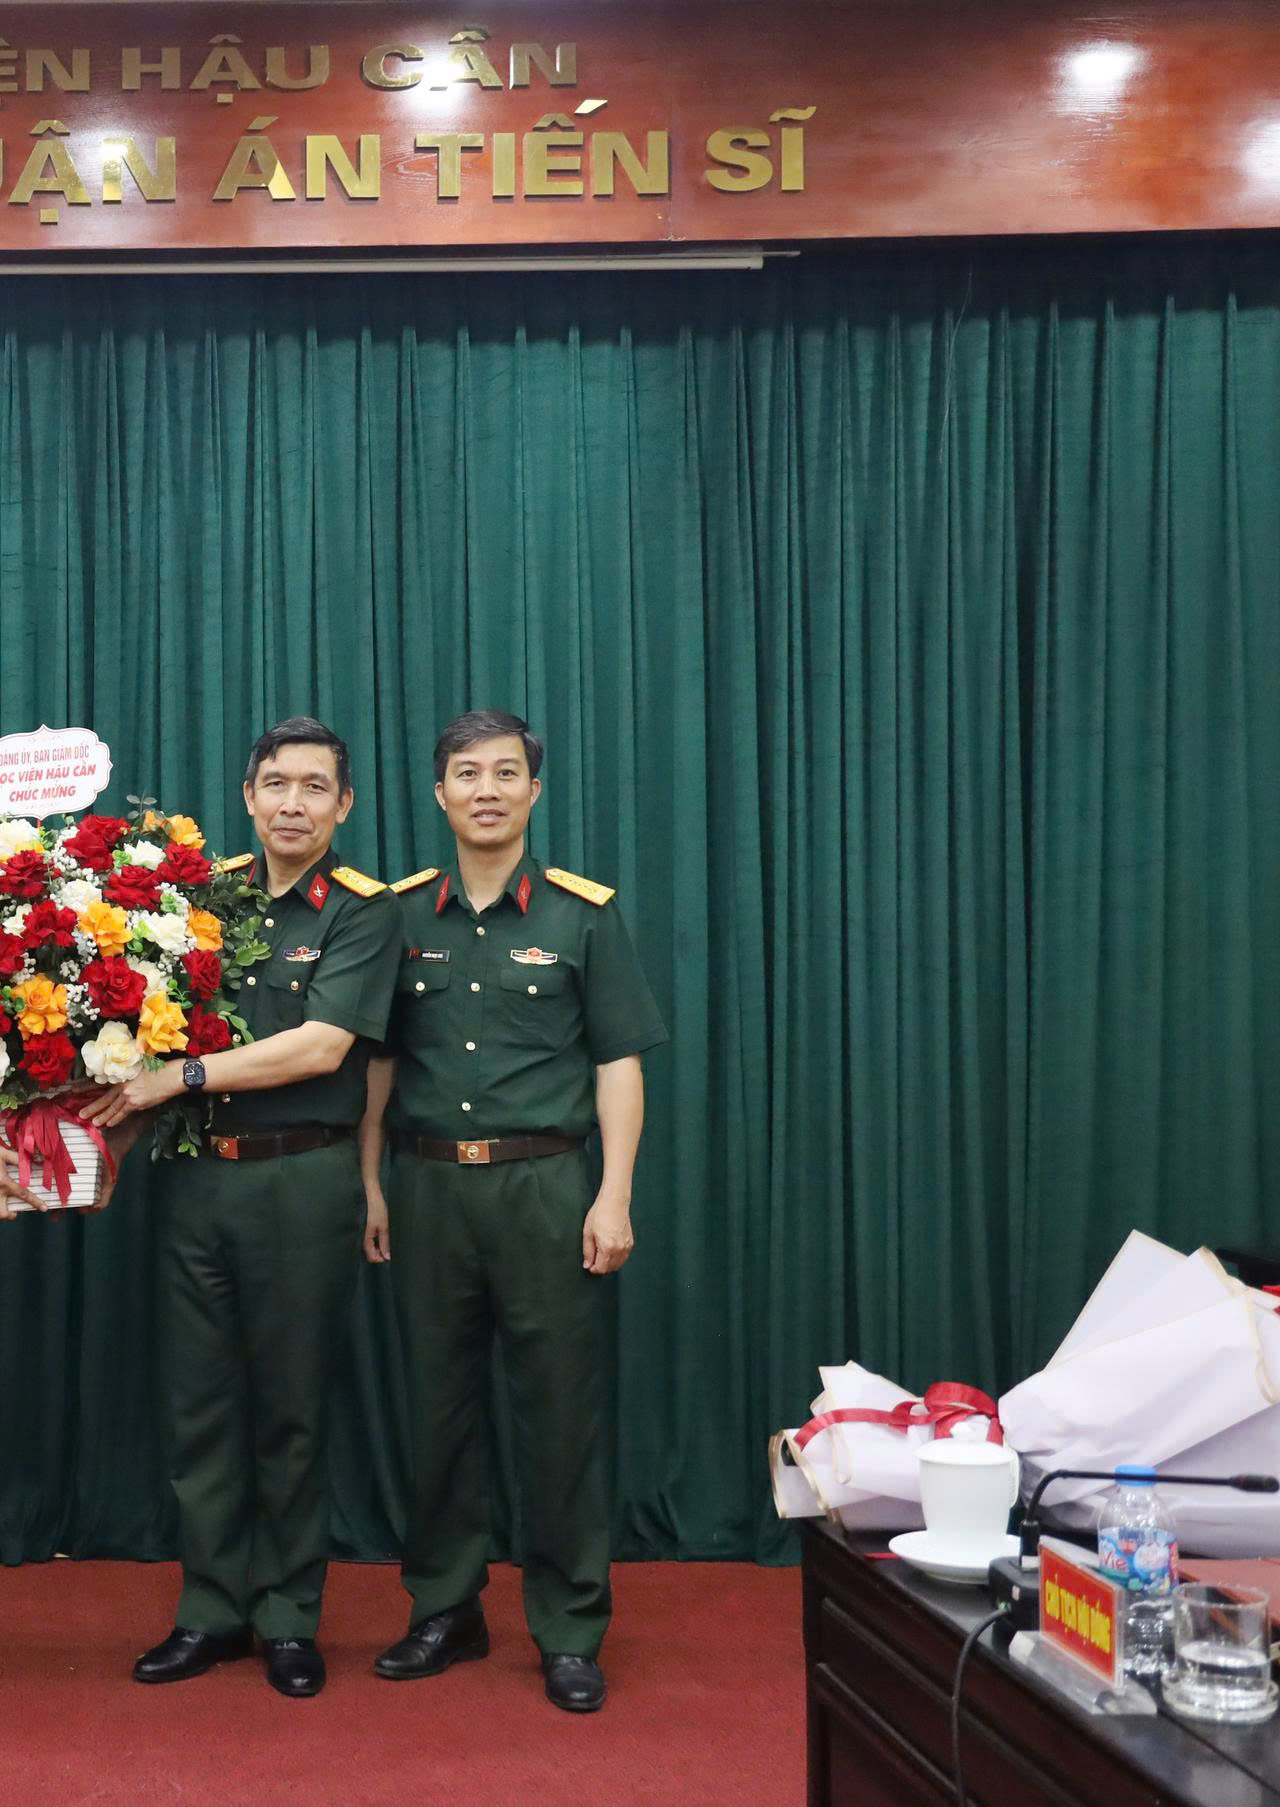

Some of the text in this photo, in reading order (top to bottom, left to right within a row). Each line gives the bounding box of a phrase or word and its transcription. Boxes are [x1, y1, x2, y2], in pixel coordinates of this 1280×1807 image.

[121, 34, 329, 103] HẬU
[361, 26, 579, 91] CẦN
[211, 115, 381, 201] ÁN
[414, 98, 669, 200] TIẾN
[705, 106, 818, 193] SĨ
[34, 749, 51, 763] BAN
[9, 786, 38, 802] CHÚC
